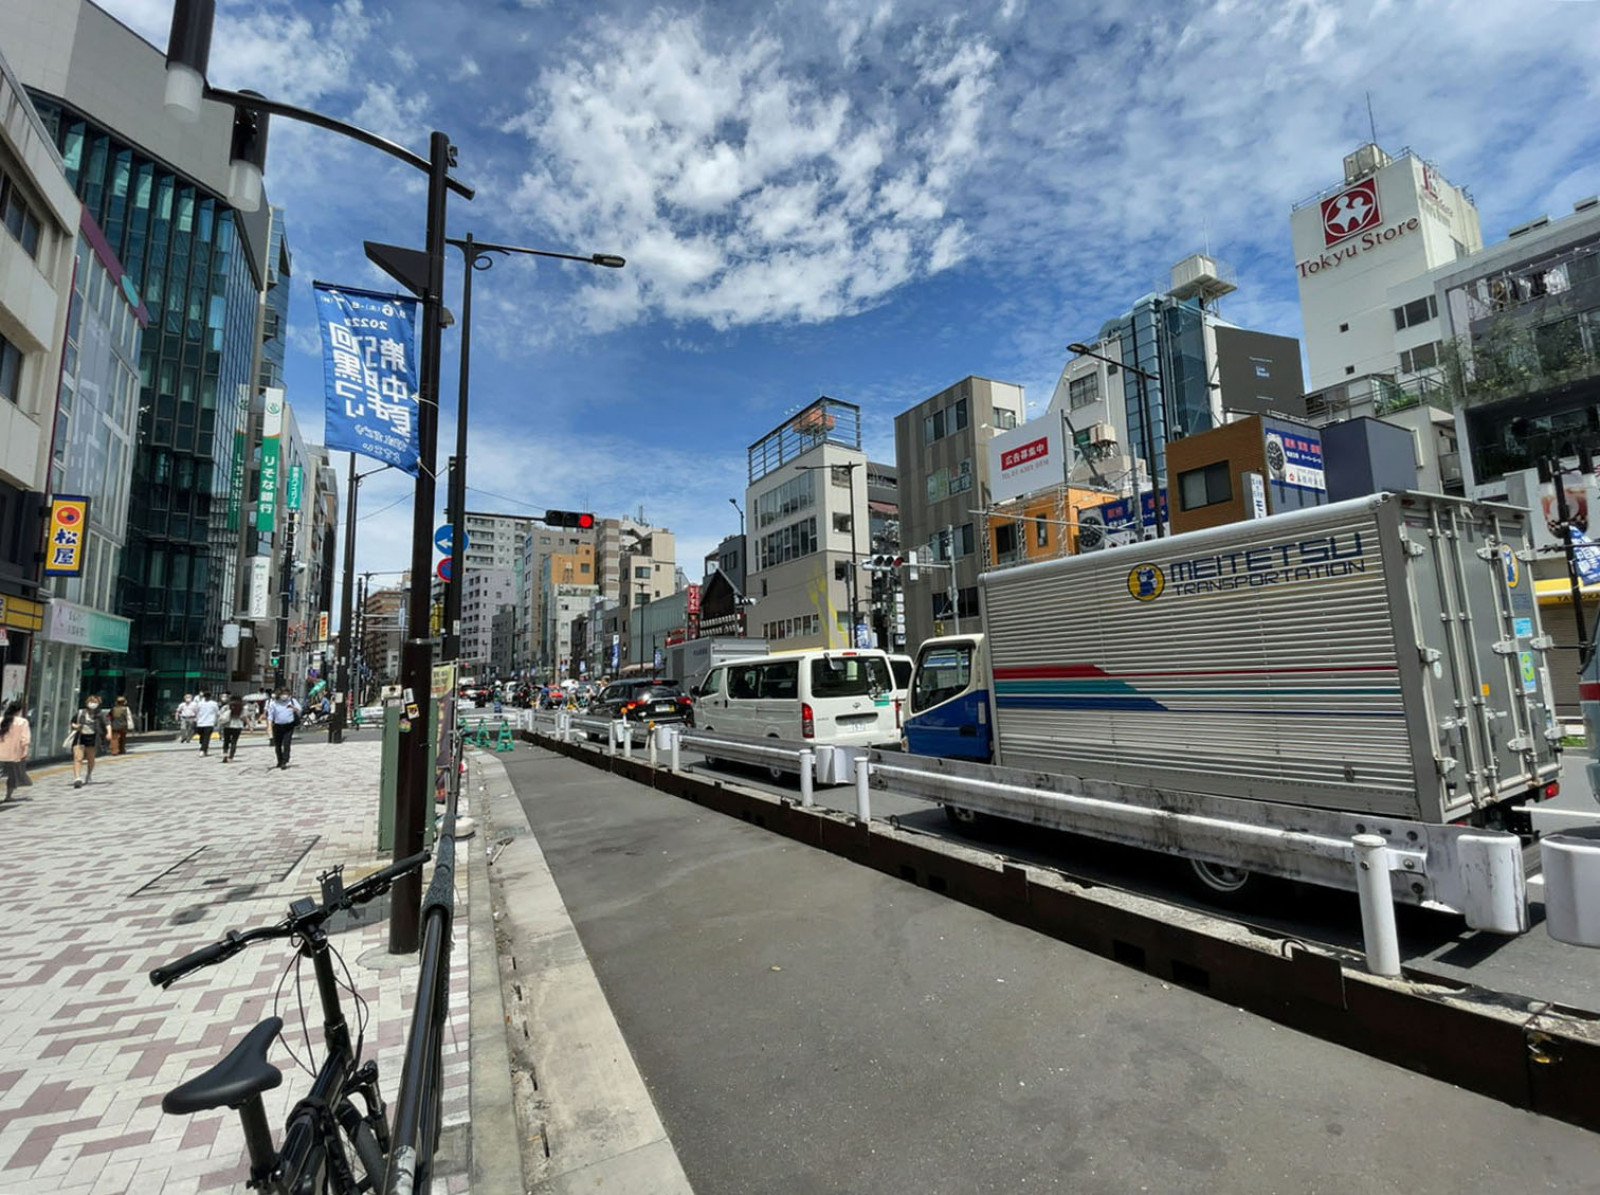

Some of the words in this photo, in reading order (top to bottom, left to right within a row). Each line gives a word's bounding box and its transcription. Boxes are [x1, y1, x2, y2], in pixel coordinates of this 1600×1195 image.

[1296, 244, 1357, 278] Tokyu
[1361, 217, 1419, 251] Store
[1004, 443, 1045, 467] 広告募集中
[260, 455, 275, 514] りそな銀行
[53, 528, 78, 565] 松屋
[1169, 532, 1363, 582] MEITETSU
[1172, 559, 1366, 596] TRANSPORTATION
